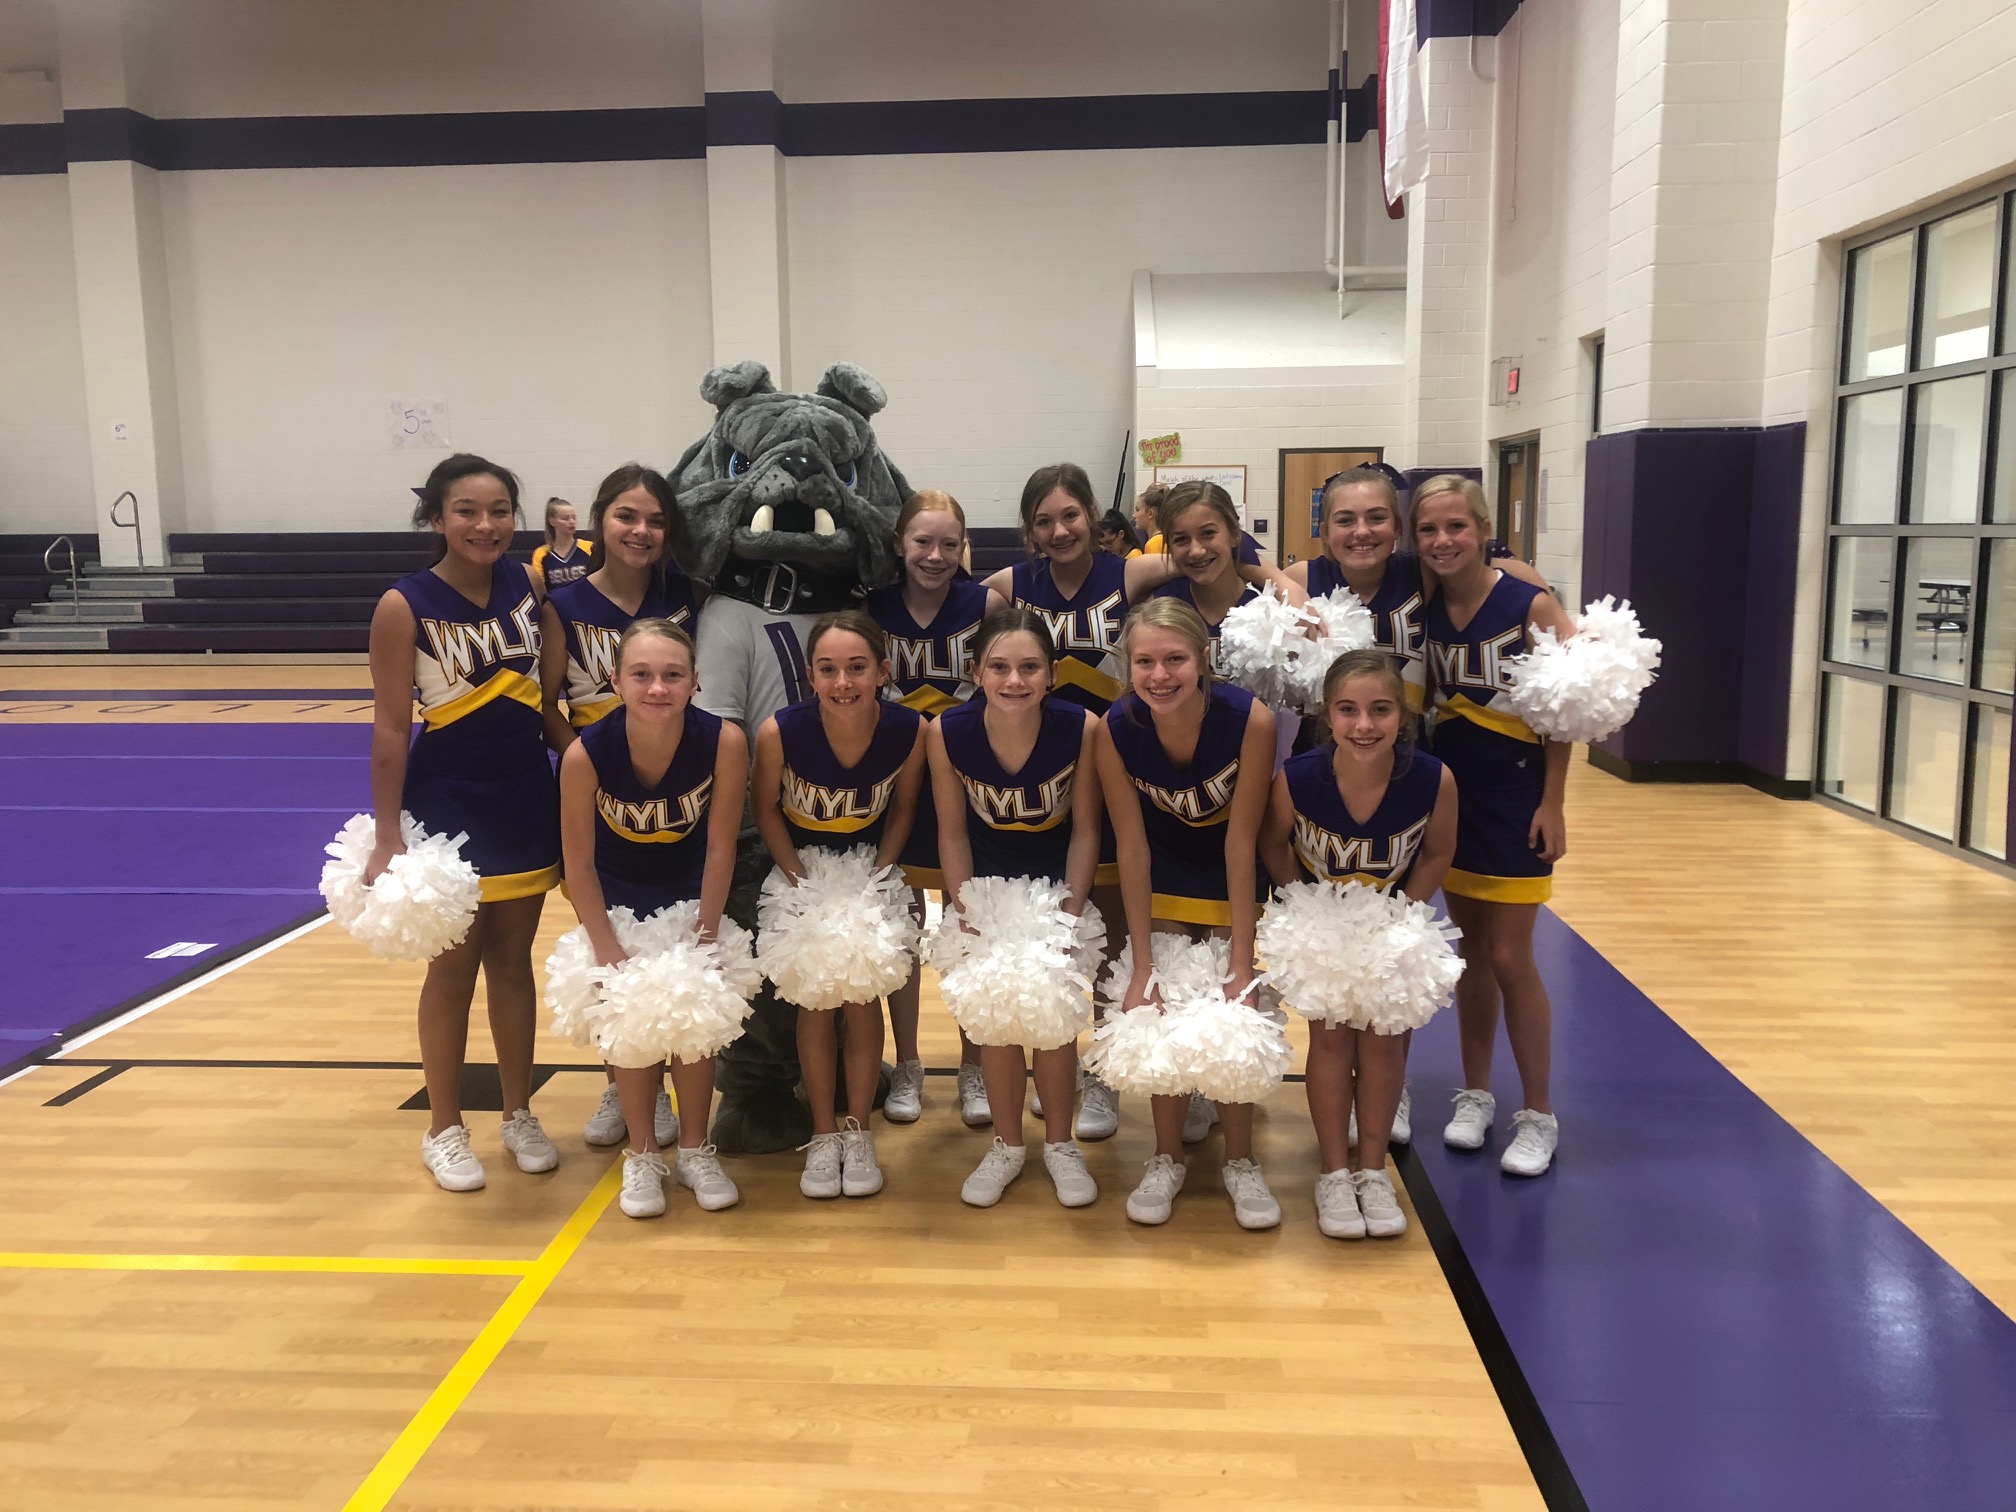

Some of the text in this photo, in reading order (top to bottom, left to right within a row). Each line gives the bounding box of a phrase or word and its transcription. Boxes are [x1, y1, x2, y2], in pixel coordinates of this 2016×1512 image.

[1145, 447, 1177, 464] of you
[1155, 433, 1180, 453] proud
[421, 592, 542, 687] WYLIE
[1016, 589, 1122, 656] YLIE
[1427, 625, 1521, 692] YLIE
[1294, 812, 1430, 870] WYLIE
